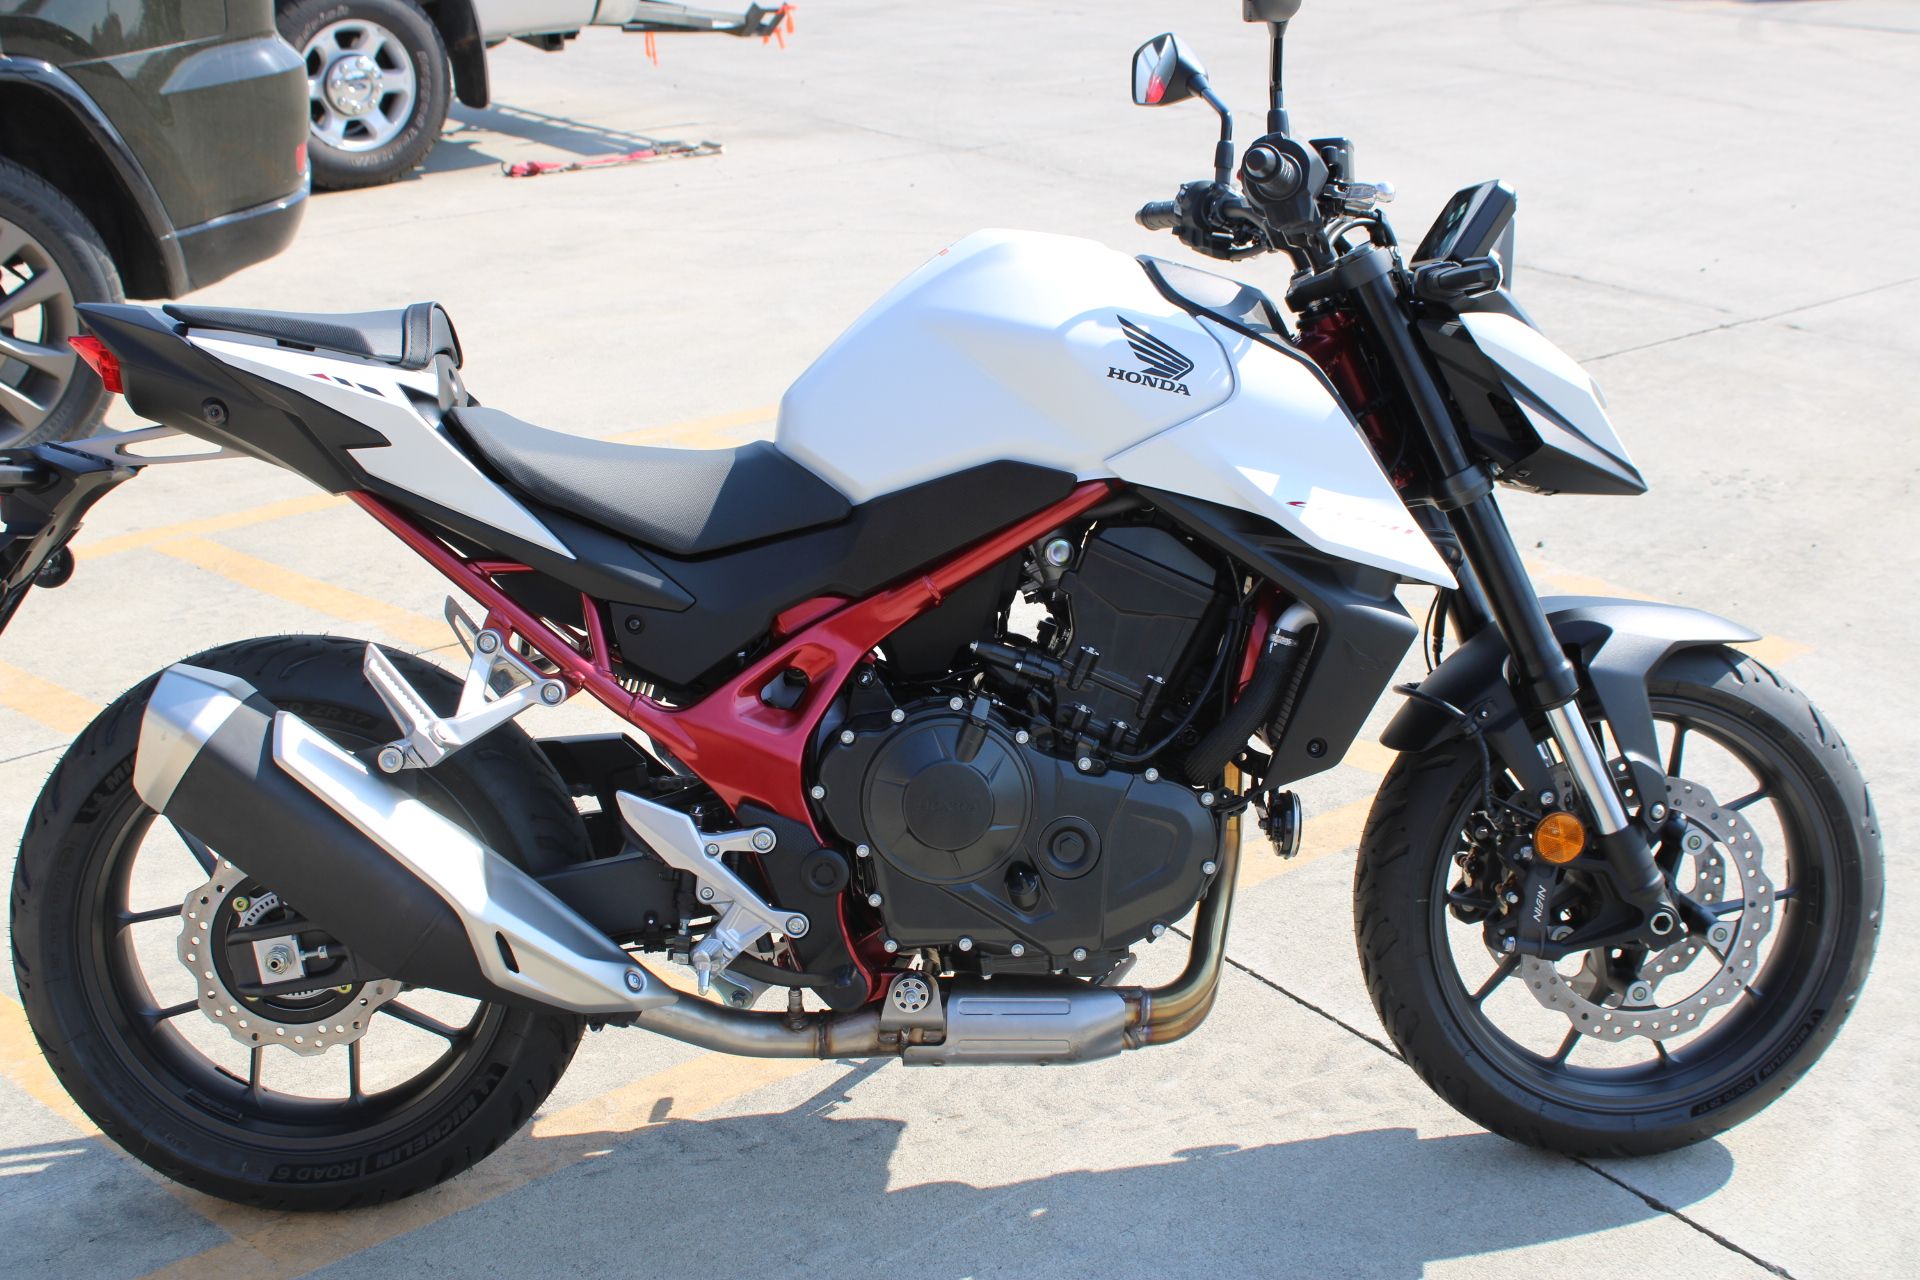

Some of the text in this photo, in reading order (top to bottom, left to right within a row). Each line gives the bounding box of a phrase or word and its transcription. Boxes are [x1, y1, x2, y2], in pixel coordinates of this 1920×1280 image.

[1106, 366, 1191, 396] HONDA
[1761, 1025, 1809, 1077] MICHELIN
[275, 1093, 478, 1181] MICHELIN ROAD 6
